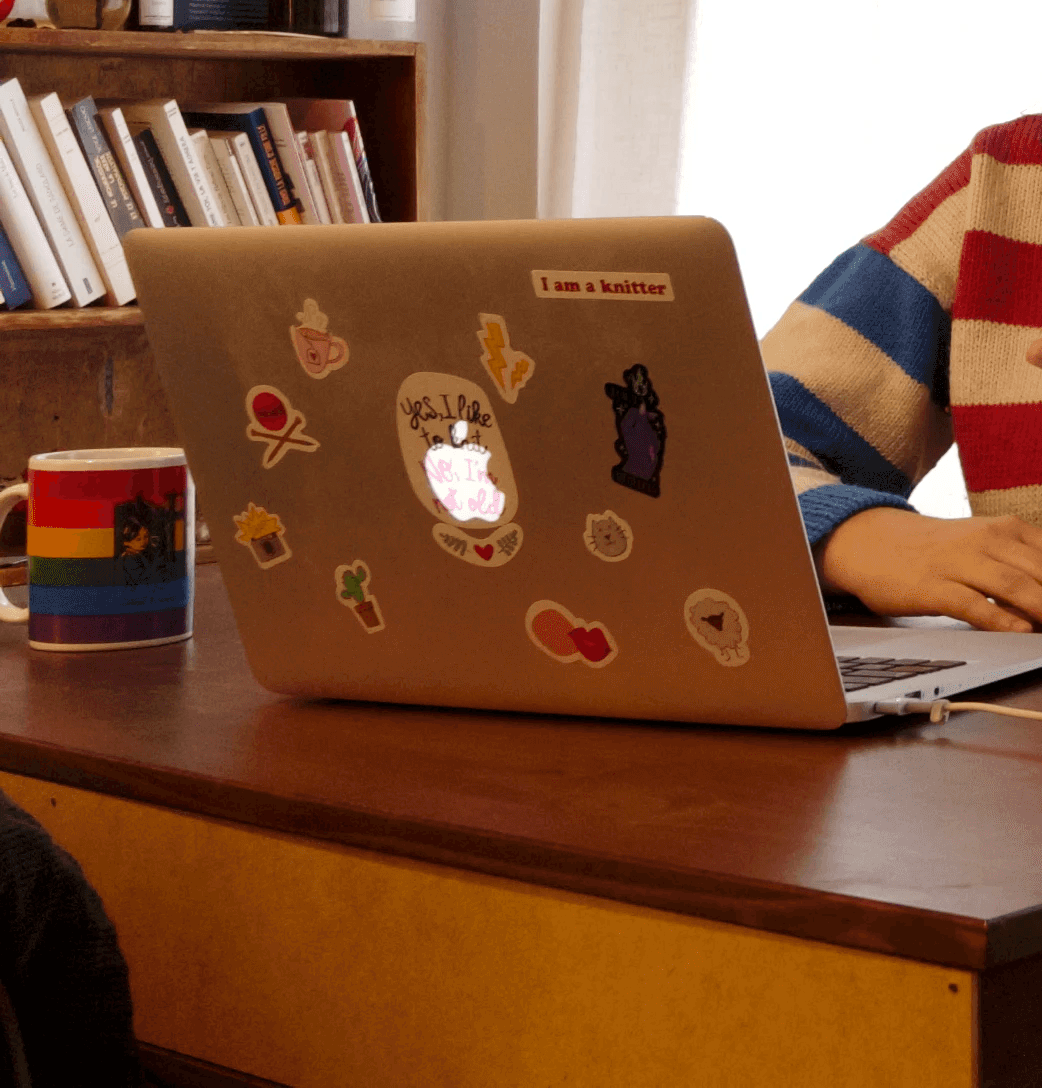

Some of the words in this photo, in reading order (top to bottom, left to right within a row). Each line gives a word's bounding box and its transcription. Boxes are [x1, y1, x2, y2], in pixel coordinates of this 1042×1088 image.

[540, 277, 549, 291] I
[554, 281, 581, 292] am
[585, 282, 596, 293] a
[600, 279, 667, 295] knitter
[457, 394, 493, 428] like
[420, 427, 445, 450] to
